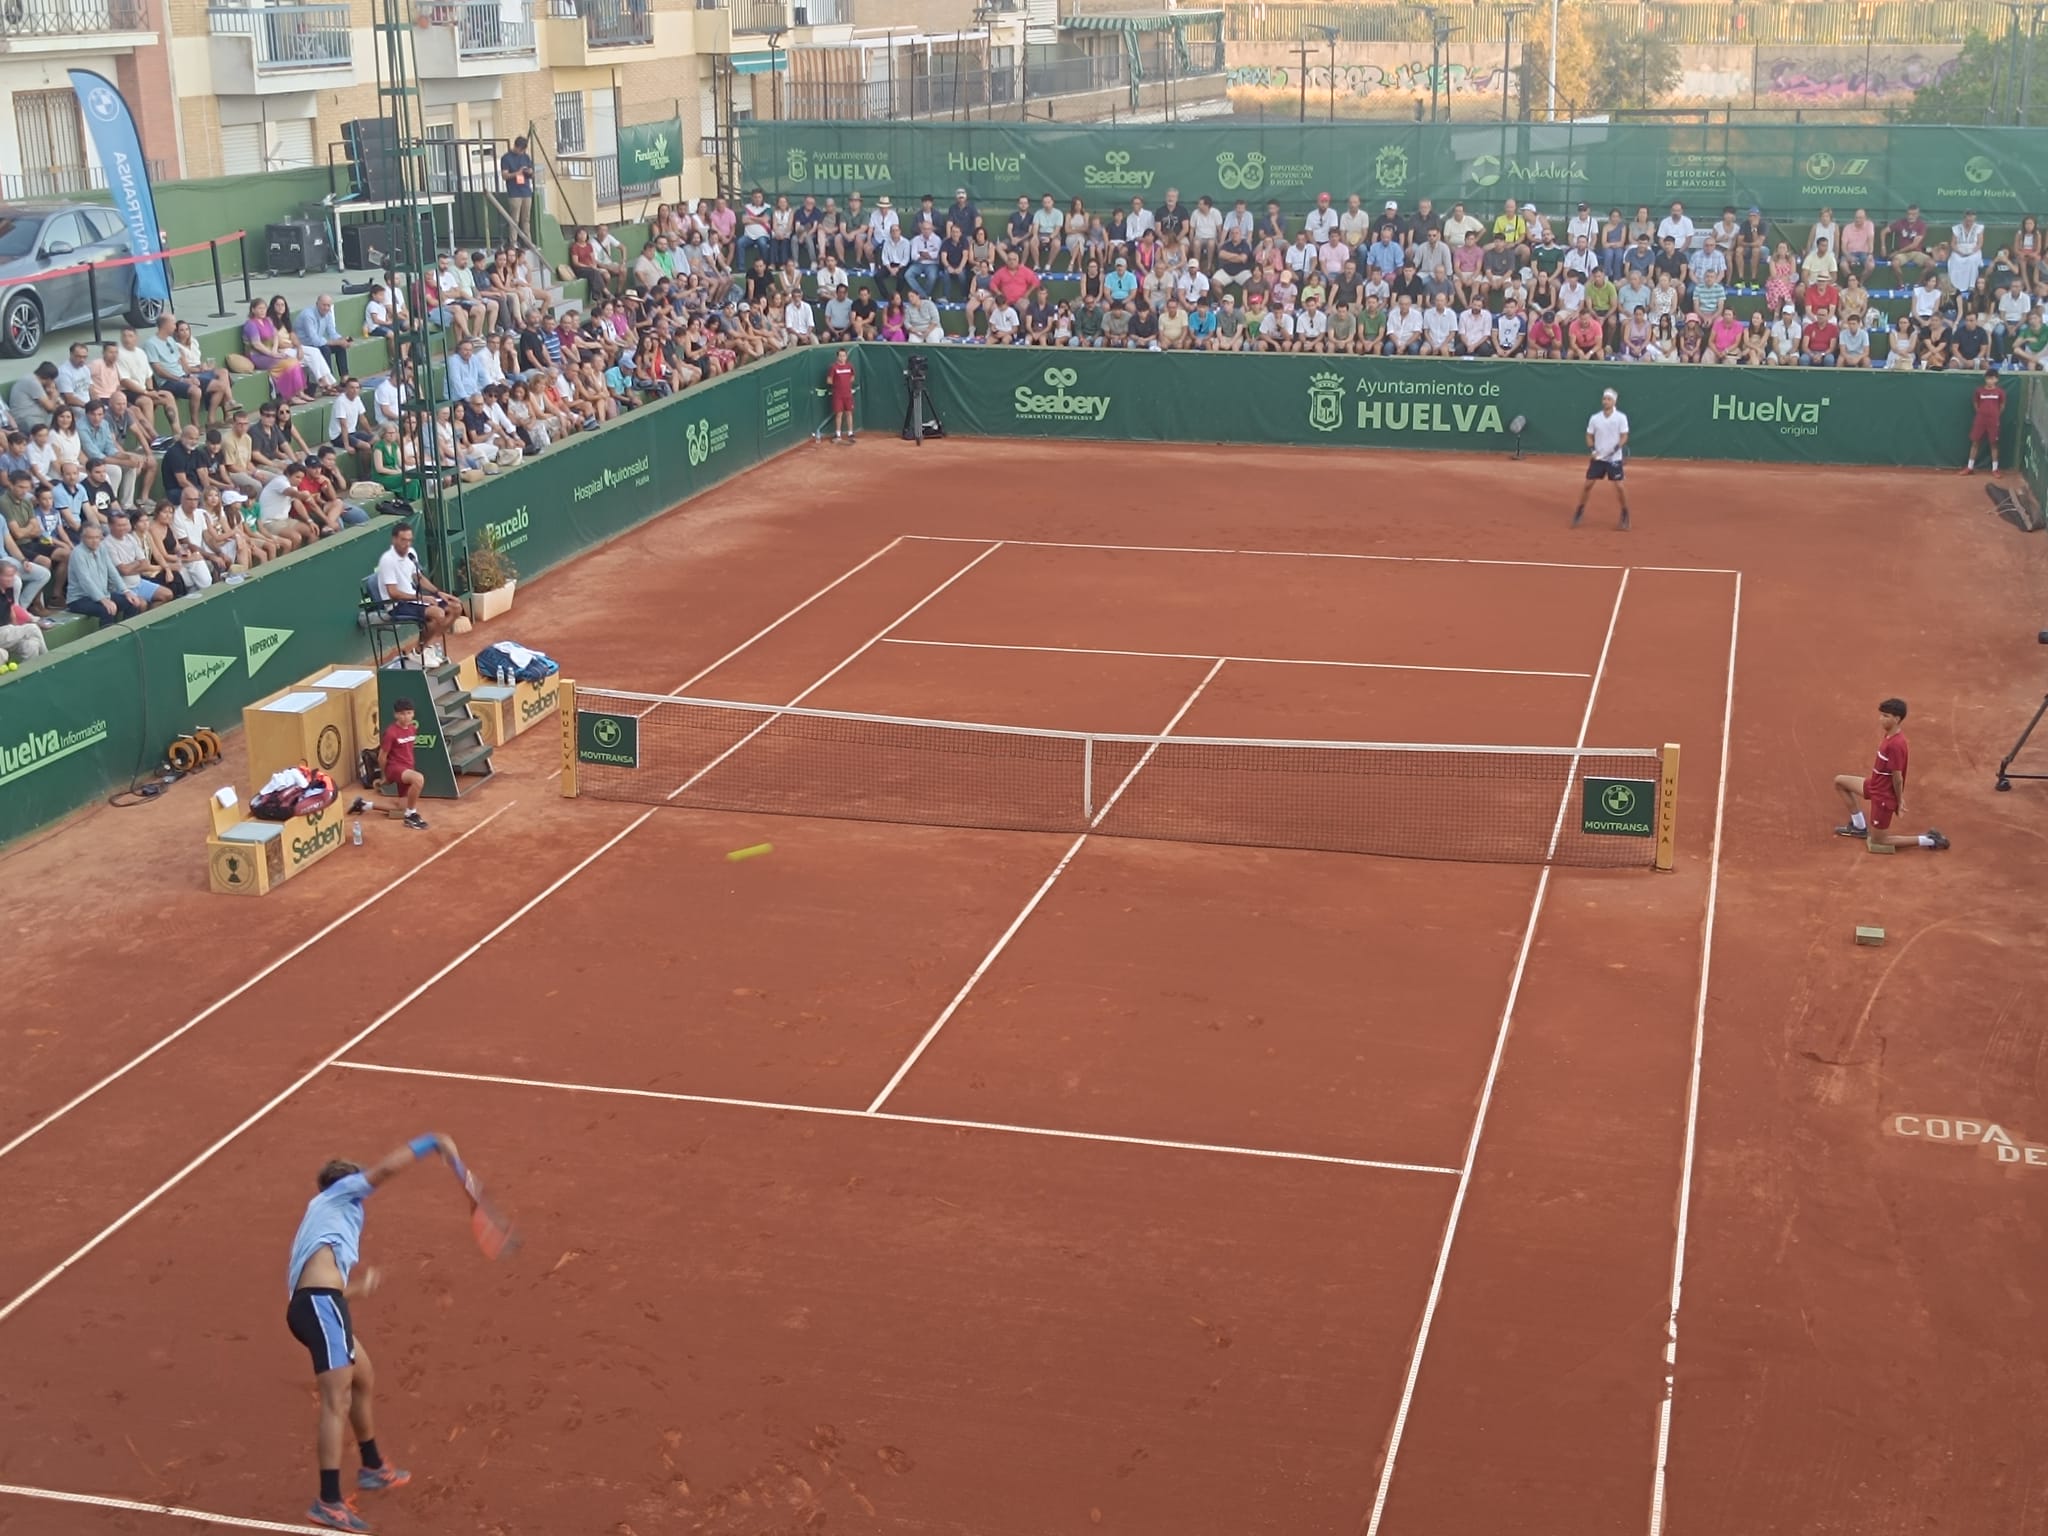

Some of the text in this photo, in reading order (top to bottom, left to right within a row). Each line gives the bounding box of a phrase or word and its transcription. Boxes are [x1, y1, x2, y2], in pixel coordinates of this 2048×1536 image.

[812, 151, 889, 162] Ayuntamiento de
[948, 152, 1020, 172] Huelva
[813, 163, 892, 180] HUELVA
[1084, 165, 1155, 189] Seabery
[1507, 160, 1590, 181] Andalucía
[1666, 170, 1727, 178] RESIDENCIA
[1801, 185, 1868, 195] MOVITRANSA
[1937, 187, 2017, 198] Puerto de Huelva
[1356, 377, 1500, 397] Ayuntamiento de
[1014, 386, 1111, 421] Seabery
[1712, 394, 1820, 423] Huelva
[1356, 401, 1504, 433] HUELVA
[1780, 425, 1818, 438] original
[573, 476, 604, 503] Hospital
[486, 505, 529, 545] Parceló
[249, 633, 279, 656] HIPERCOR
[521, 688, 560, 722] Seabery
[60, 719, 107, 748] Información
[562, 710, 571, 770] HUELVA
[580, 750, 634, 764] MOVITRANSA
[1662, 778, 1673, 843] HUELVA
[1584, 821, 1650, 832] MOVITRANSA
[292, 819, 343, 864] Seabery
[1895, 1115, 2013, 1145] COPA
[1997, 1145, 2047, 1166] DE
